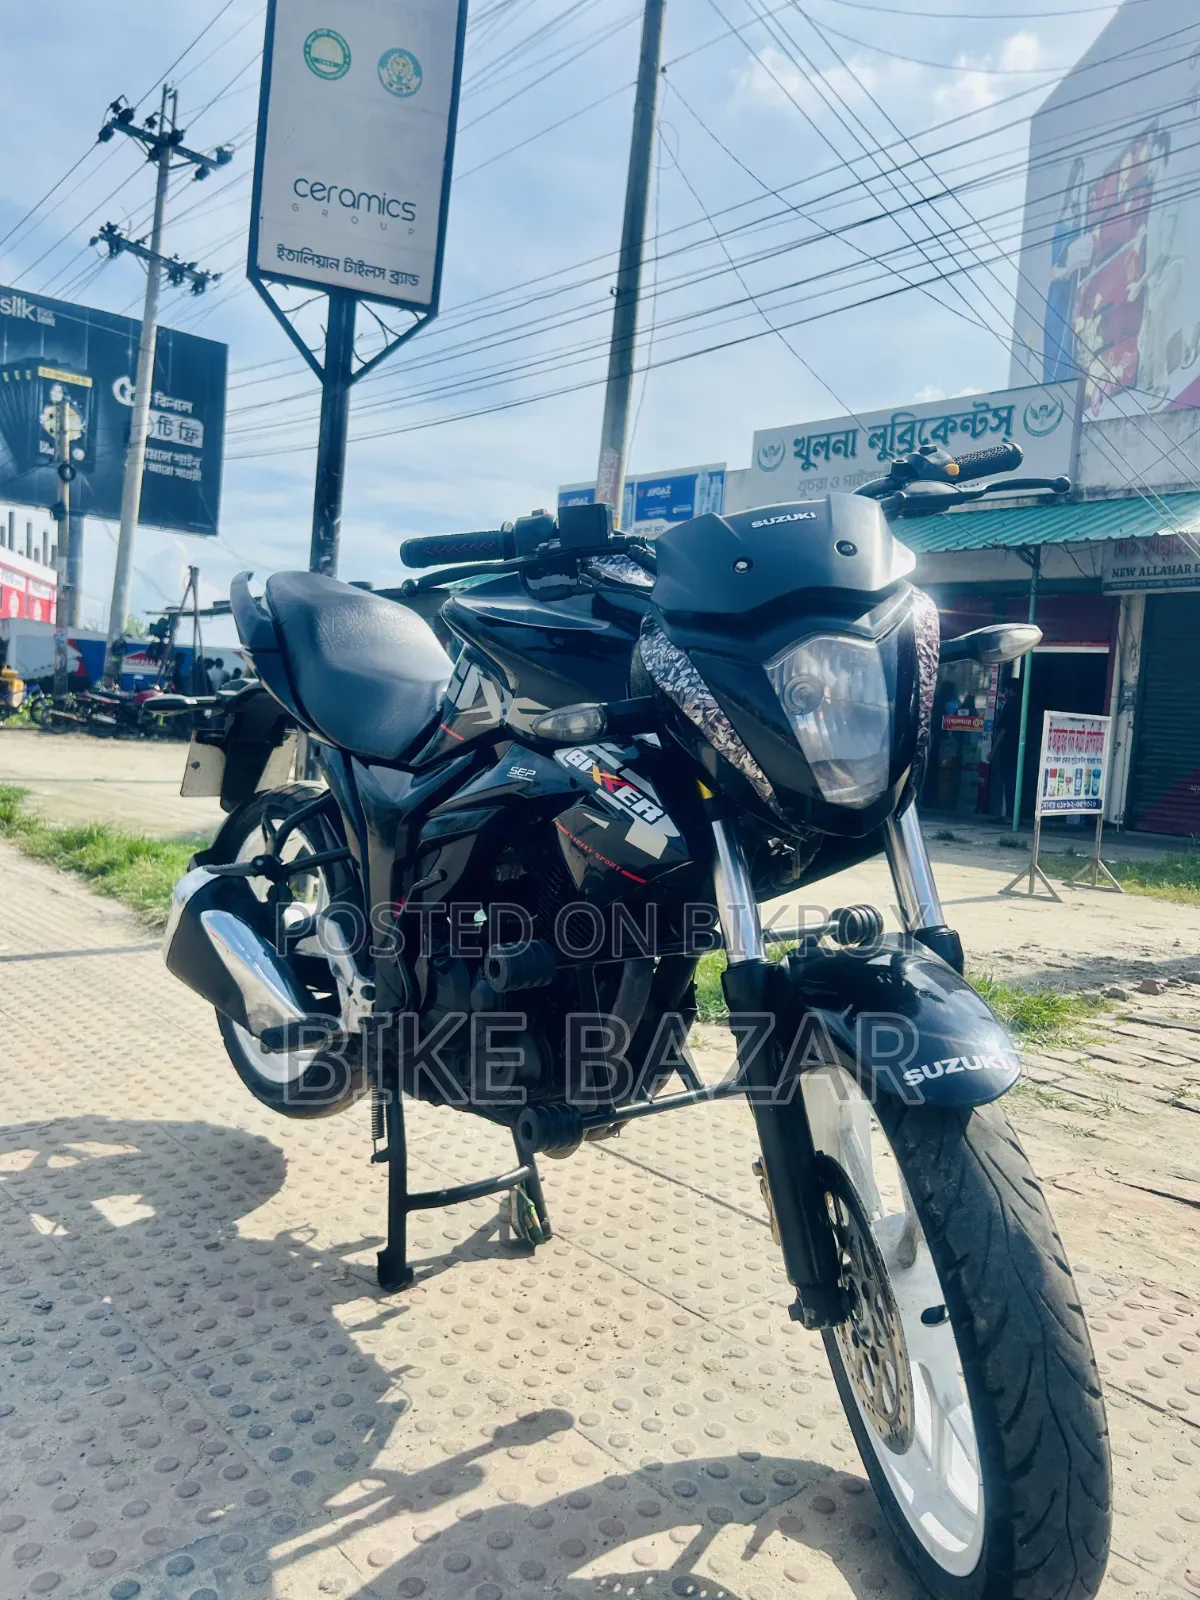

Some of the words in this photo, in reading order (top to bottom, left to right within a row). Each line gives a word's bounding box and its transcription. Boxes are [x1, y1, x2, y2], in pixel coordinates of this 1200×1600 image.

[294, 178, 416, 222] ceramics
[292, 203, 415, 236] GROUP
[277, 244, 341, 272] ইতালিয়ান
[343, 257, 386, 280] টাইলস
[793, 428, 857, 471] খুলনা
[751, 511, 817, 529] SUZUKI
[1111, 567, 1136, 578] NEW
[1138, 564, 1192, 577] ALLAHAR
[508, 766, 536, 778] SEP
[564, 749, 665, 826] GIXXER
[568, 833, 594, 853] STREET
[595, 853, 621, 870] SPORT
[903, 1054, 1010, 1087] SUZUKI
